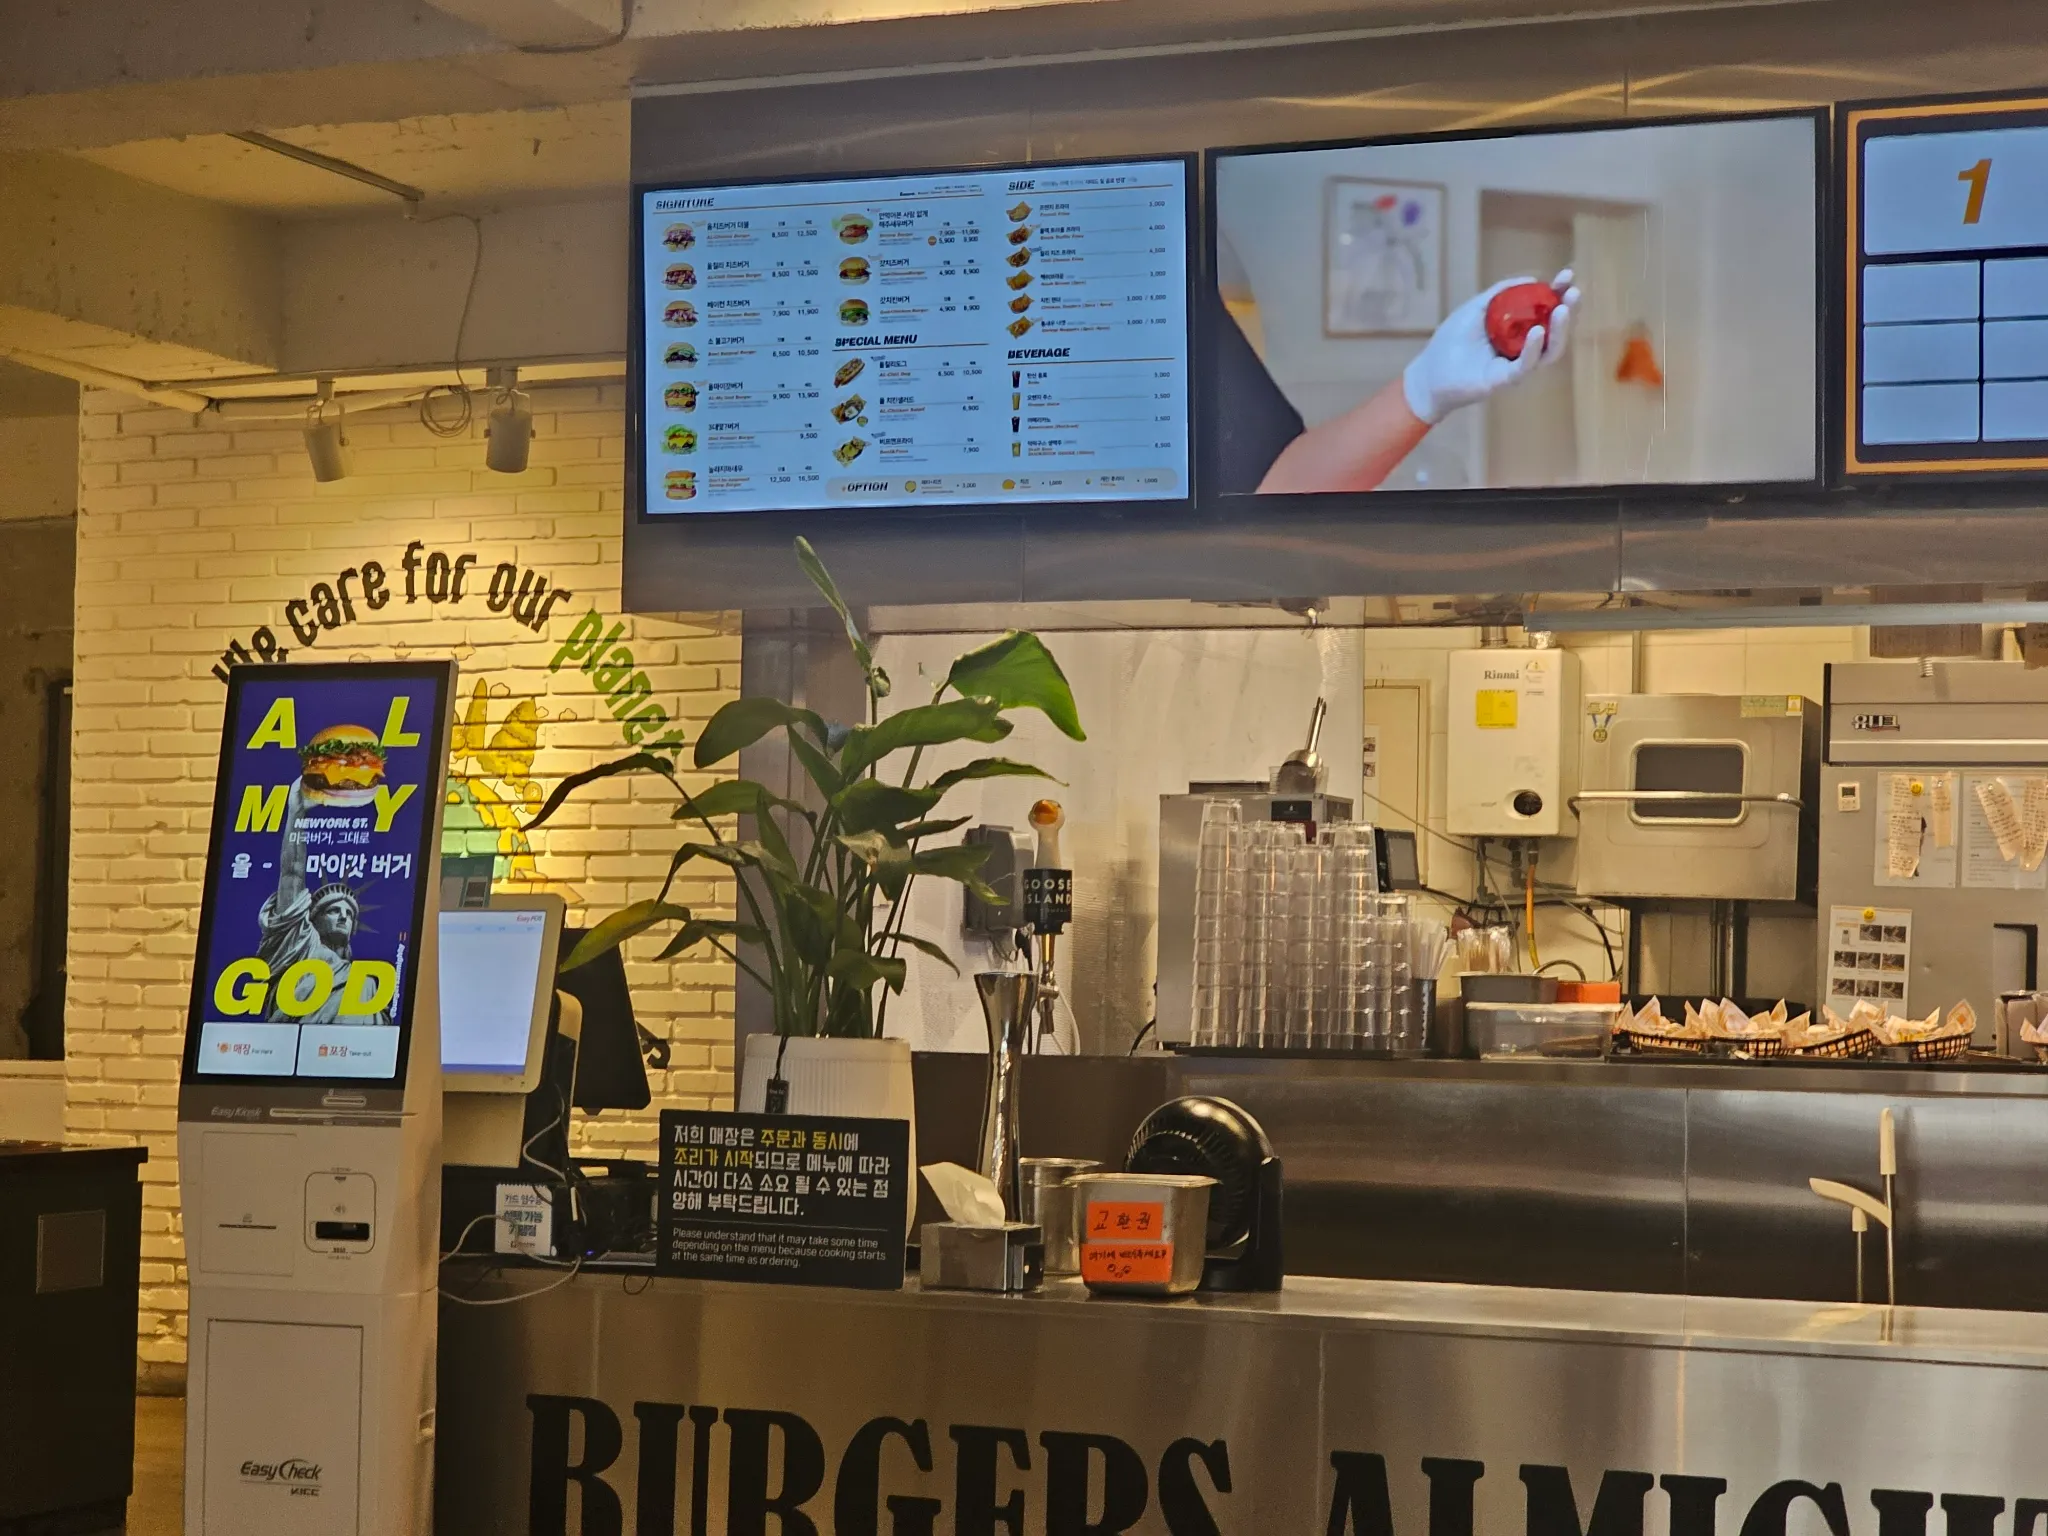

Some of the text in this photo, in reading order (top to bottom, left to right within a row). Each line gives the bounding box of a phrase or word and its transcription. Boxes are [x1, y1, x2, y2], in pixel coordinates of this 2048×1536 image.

[1008, 180, 1036, 191] SIDE
[1957, 158, 1993, 224] 1
[772, 308, 819, 318] 7,900 11,900
[835, 334, 918, 347] SPECIAL MENU
[798, 349, 819, 357] 10,500
[1008, 348, 1070, 360] BEVERAGE
[800, 432, 818, 440] 9,500
[286, 560, 390, 648] care
[402, 540, 478, 605] for
[487, 562, 573, 633] our
[547, 608, 685, 756] planet
[1484, 670, 1520, 680] Rinnai
[246, 696, 421, 749] A L
[234, 784, 418, 833] M Y
[351, 818, 369, 829] ST.
[289, 832, 370, 846] 미국버거, 그대로
[371, 853, 412, 879] 버거
[214, 958, 397, 1018] GOD
[234, 1043, 251, 1056] 매장
[329, 1046, 348, 1057] 포장
[674, 1125, 859, 1152] 저희 매장은 주문과 동시에
[674, 1148, 891, 1176] 조리가 시작되므로 메뉴에 따라
[673, 1170, 889, 1198] 시간이 다소 소요 될 수 있는 점
[672, 1193, 804, 1216] 양해 부탁드립니다.
[673, 1228, 878, 1248] Please understand that it may take some time
[672, 1240, 886, 1261] depending on the menu because cooking starts
[672, 1252, 682, 1261] at
[684, 1253, 698, 1262] the
[700, 1254, 724, 1263] same
[726, 1254, 745, 1264] time
[760, 1258, 801, 1269] ordering.
